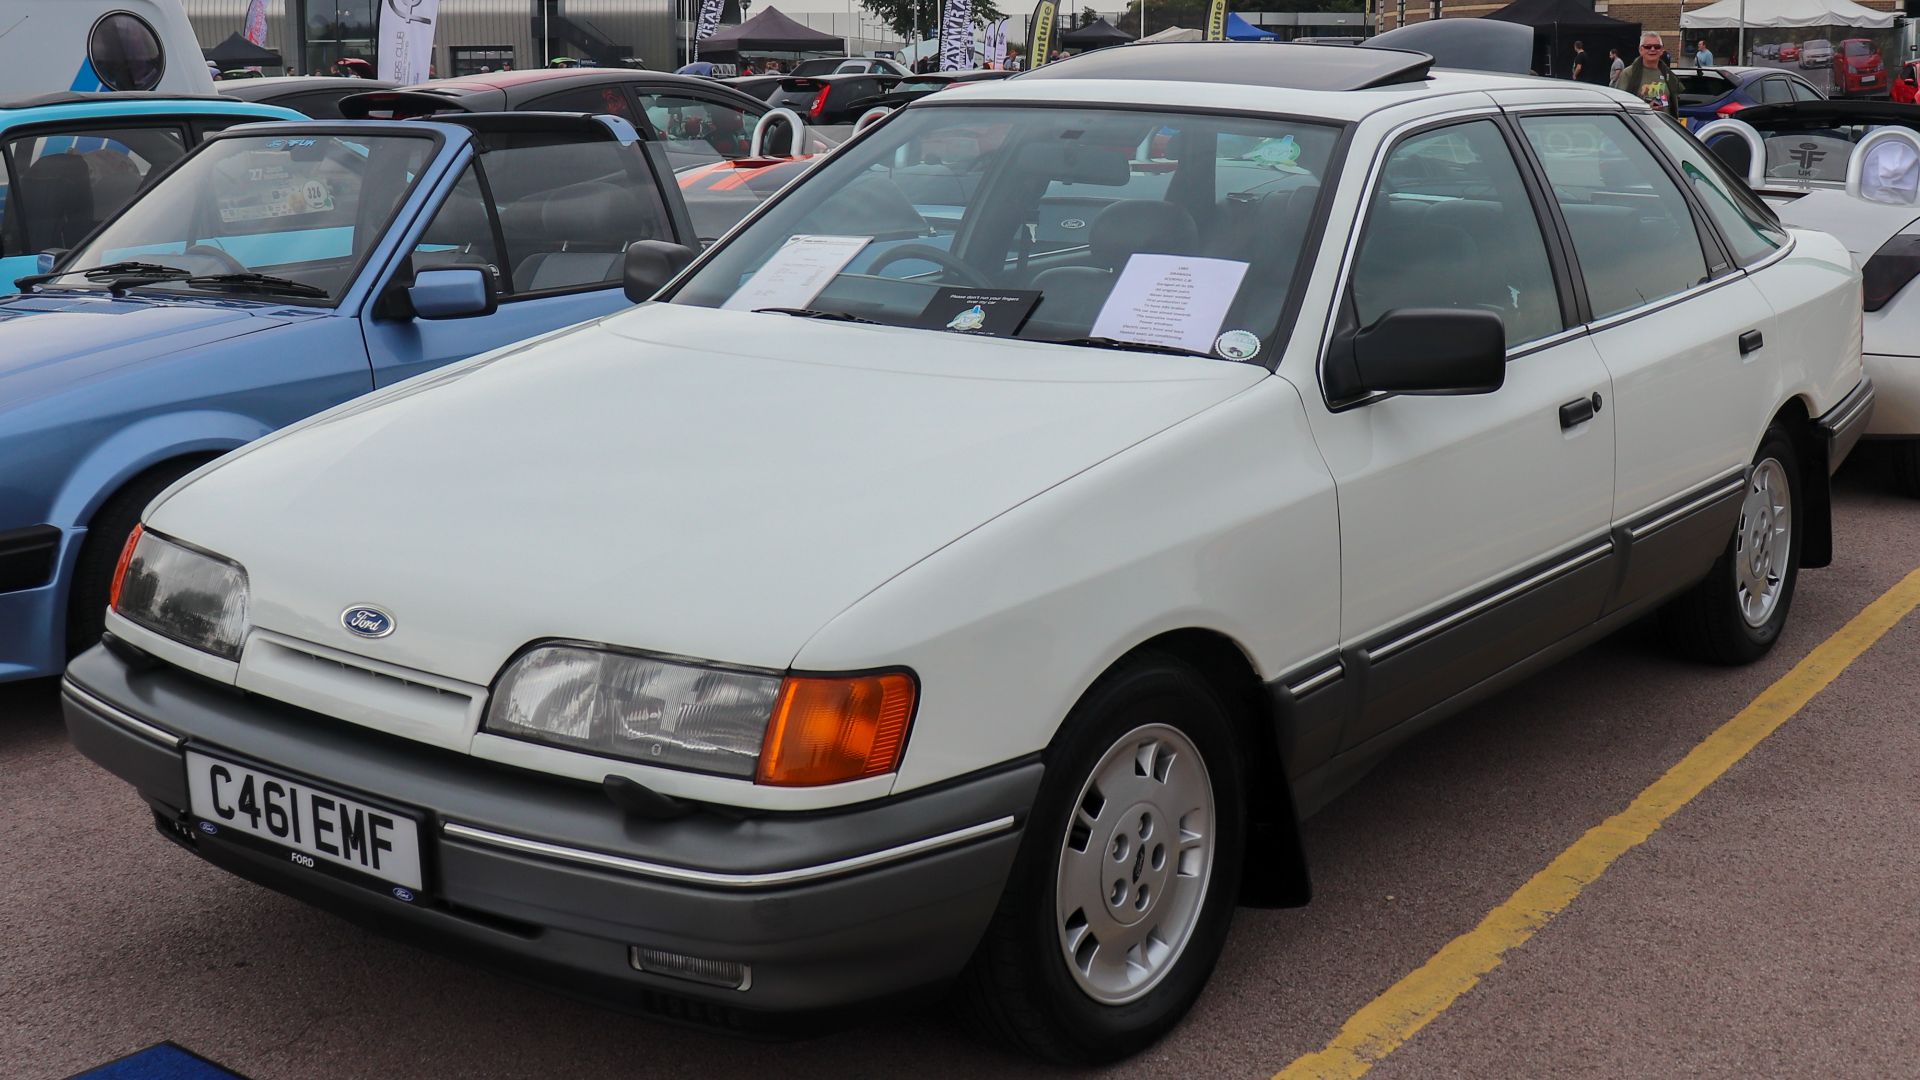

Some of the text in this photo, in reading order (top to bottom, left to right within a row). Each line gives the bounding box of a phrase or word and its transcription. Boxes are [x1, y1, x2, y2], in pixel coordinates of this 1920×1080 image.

[1798, 169, 1811, 177] UK
[307, 187, 322, 199] 326
[351, 610, 383, 631] Ford
[210, 763, 394, 870] C461 EMF
[291, 852, 315, 868] FORD
